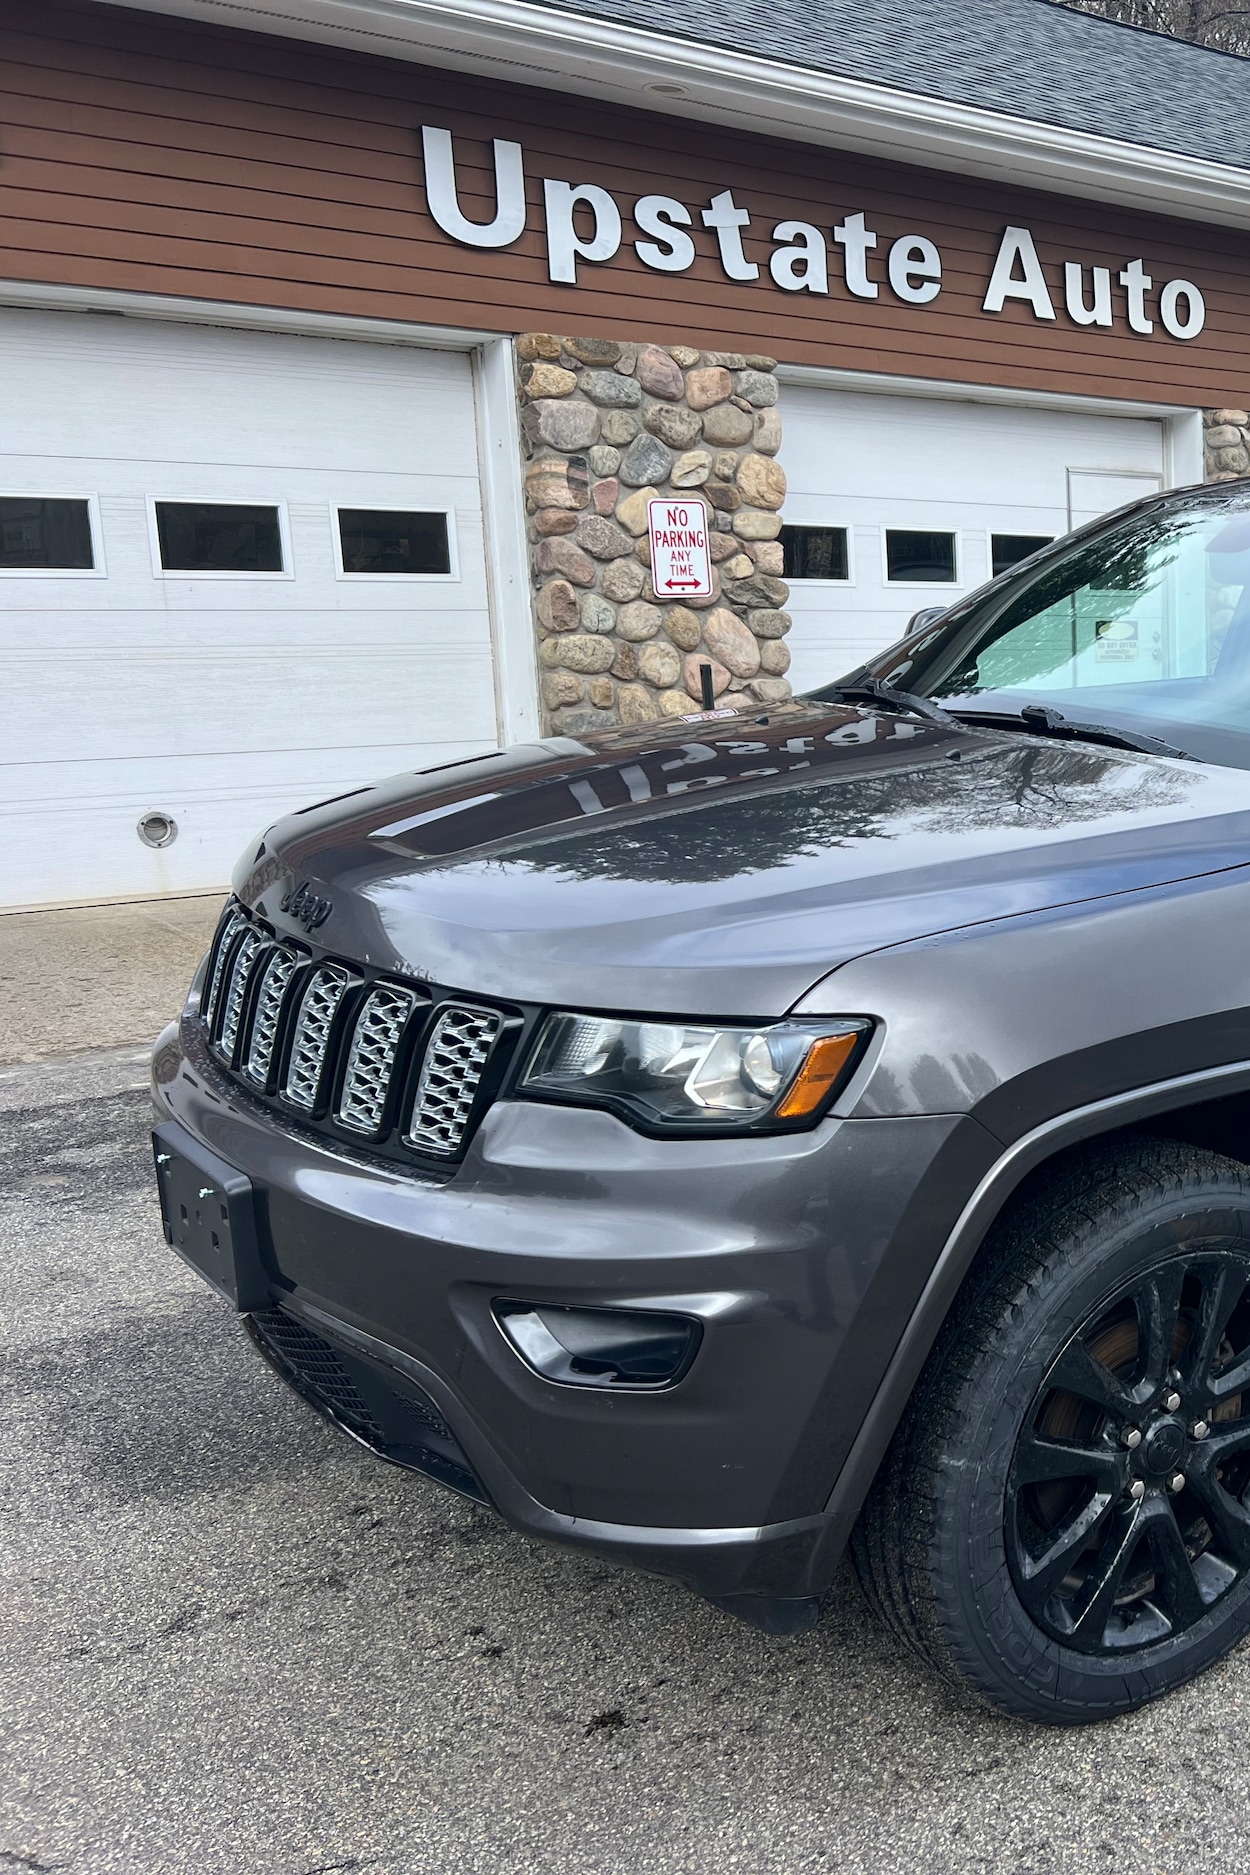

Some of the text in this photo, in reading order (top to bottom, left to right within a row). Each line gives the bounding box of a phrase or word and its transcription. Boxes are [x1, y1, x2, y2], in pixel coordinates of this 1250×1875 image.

[421, 125, 1206, 340] Upstate Auto
[667, 509, 688, 526] NO
[655, 530, 704, 548] PARKING
[670, 550, 691, 562] ANY
[670, 564, 694, 576] TIME
